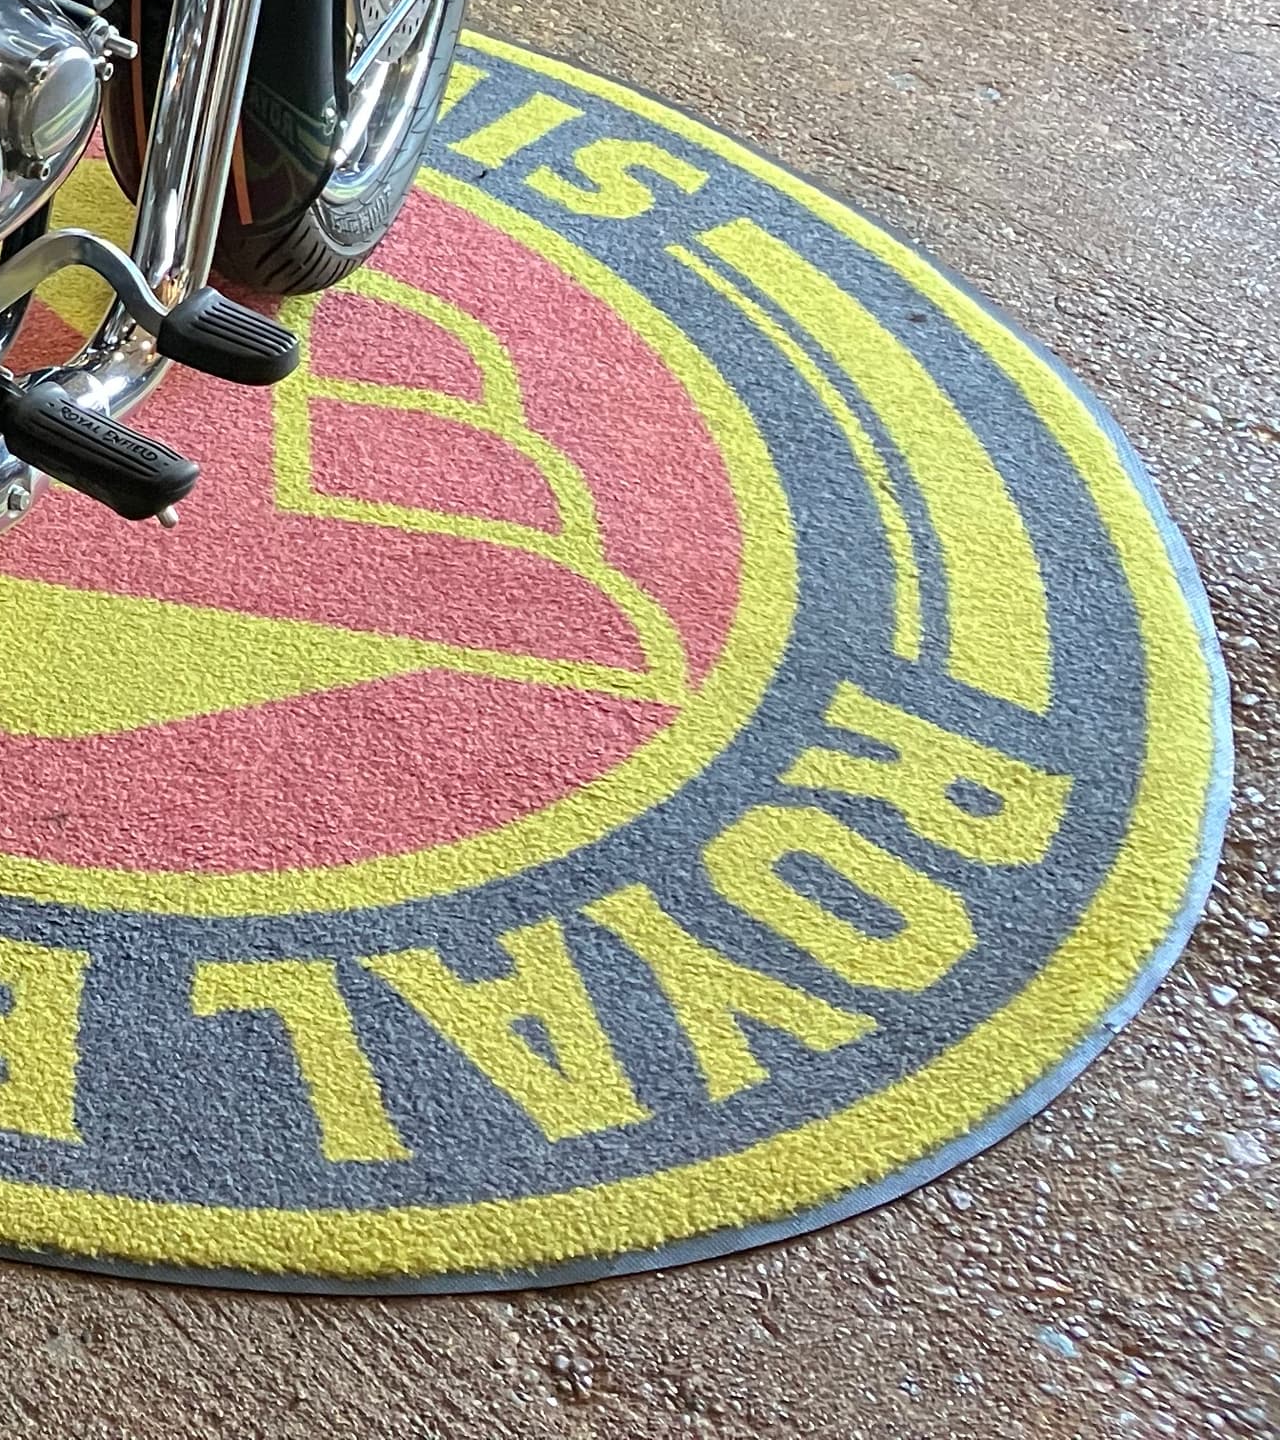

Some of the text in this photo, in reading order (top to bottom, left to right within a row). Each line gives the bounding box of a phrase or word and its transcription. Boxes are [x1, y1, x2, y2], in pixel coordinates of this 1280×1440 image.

[60, 405, 160, 462] ROYAL ENFIELD
[189, 677, 1075, 1164] ROYAL
